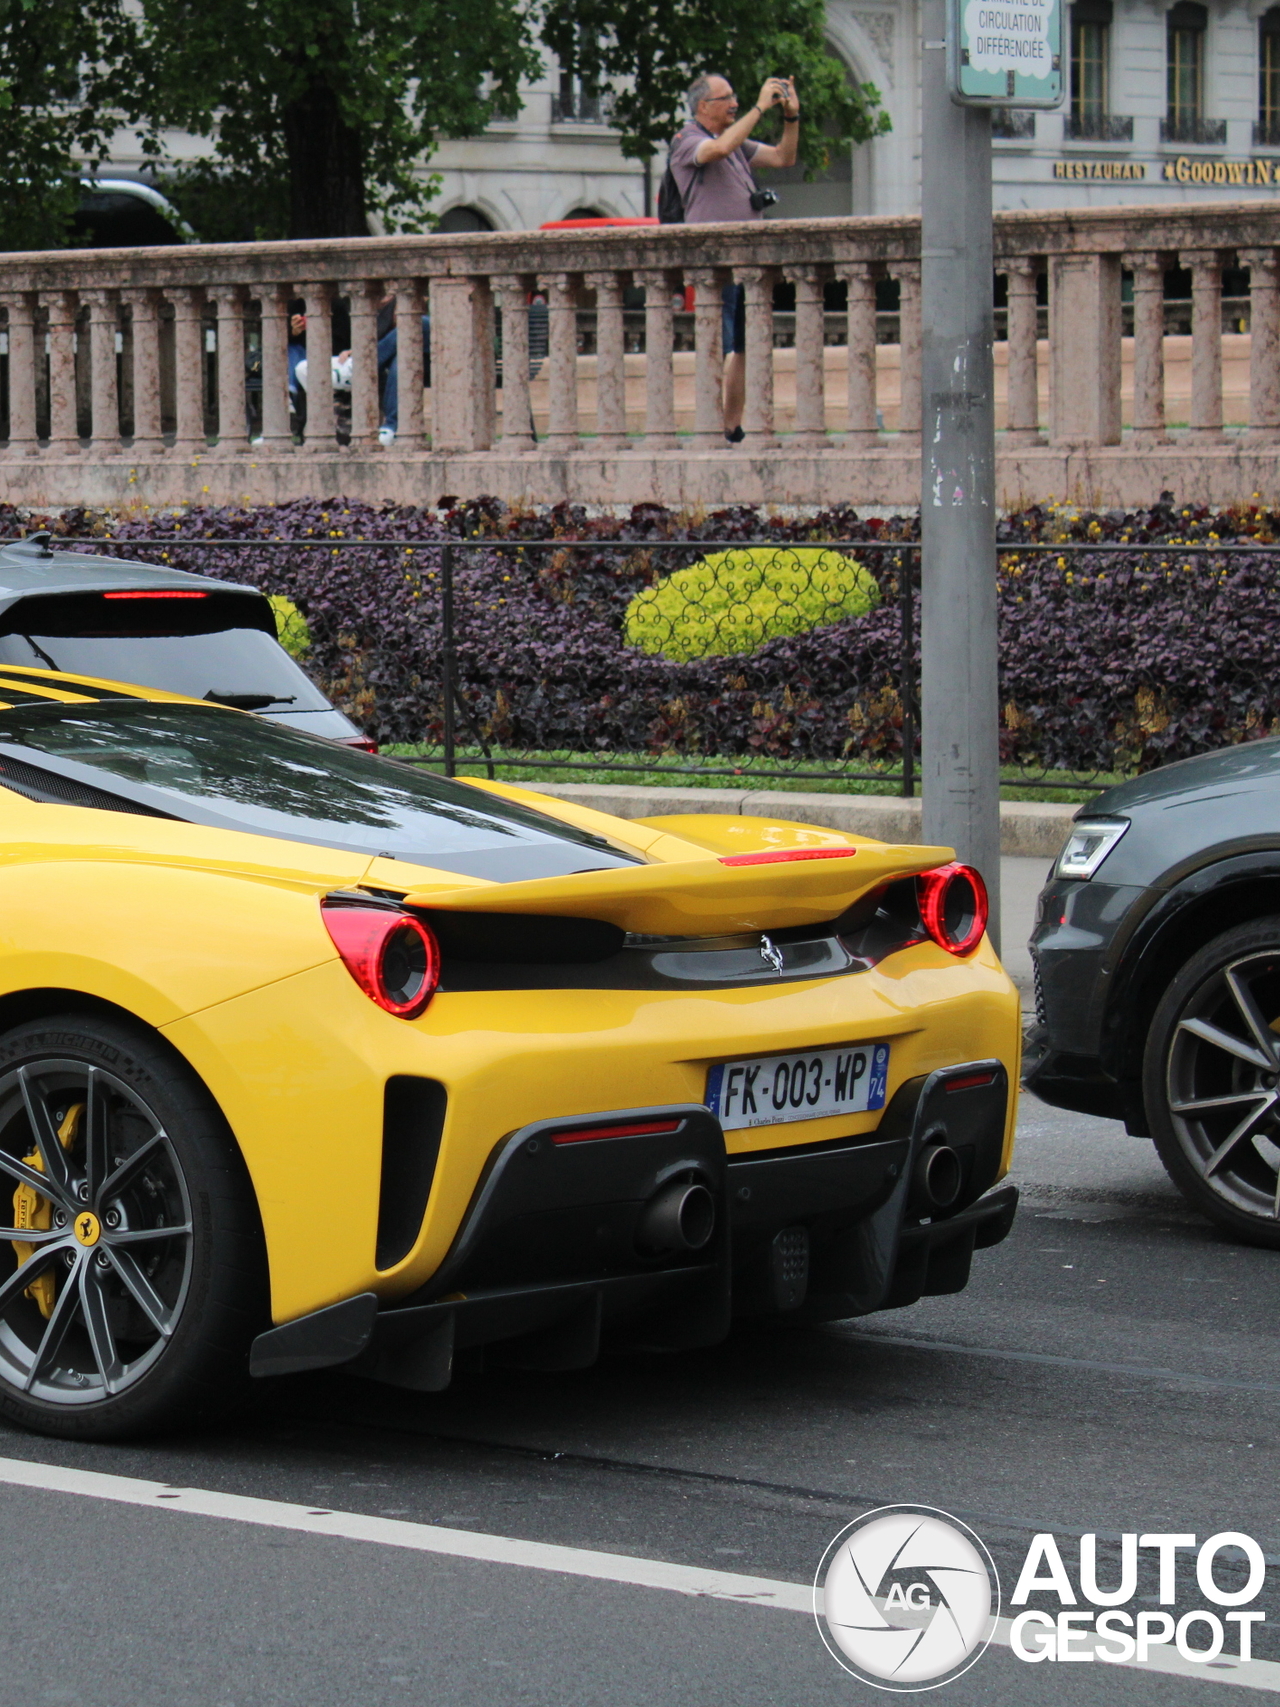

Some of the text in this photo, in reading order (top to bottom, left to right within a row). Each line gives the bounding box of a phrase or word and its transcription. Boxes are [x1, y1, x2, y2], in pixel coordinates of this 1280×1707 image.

[978, 10, 1041, 32] CIRCULATION
[976, 34, 1044, 58] DIFFÉRENCIÉE
[1055, 161, 1149, 179] RESTAURANT
[42, 1033, 119, 1061] MICHELIN
[725, 1052, 867, 1117] FK-003-WP
[870, 1077, 884, 1099] 74
